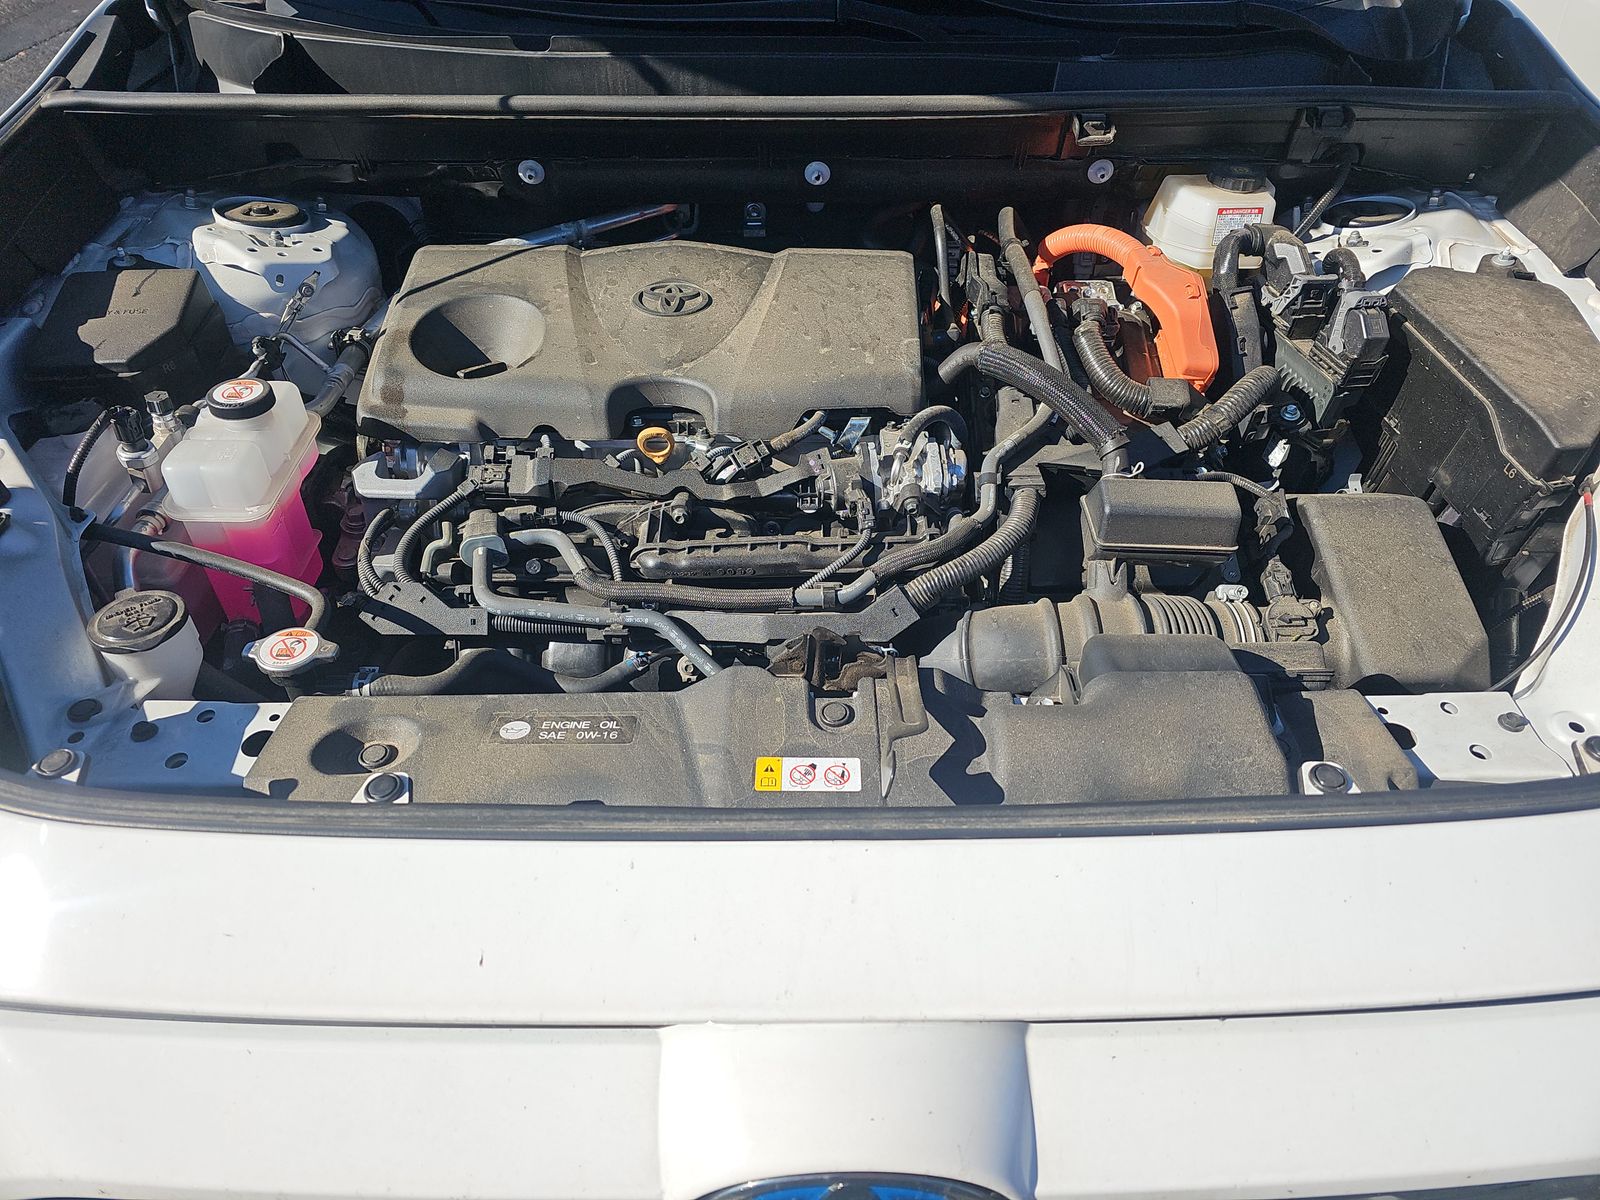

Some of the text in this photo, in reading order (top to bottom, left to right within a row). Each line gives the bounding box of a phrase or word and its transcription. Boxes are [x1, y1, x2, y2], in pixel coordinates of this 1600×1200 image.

[1503, 462, 1517, 479] L6
[541, 721, 621, 729] ENGINE OIL
[538, 731, 618, 740] SAE 0W-16
